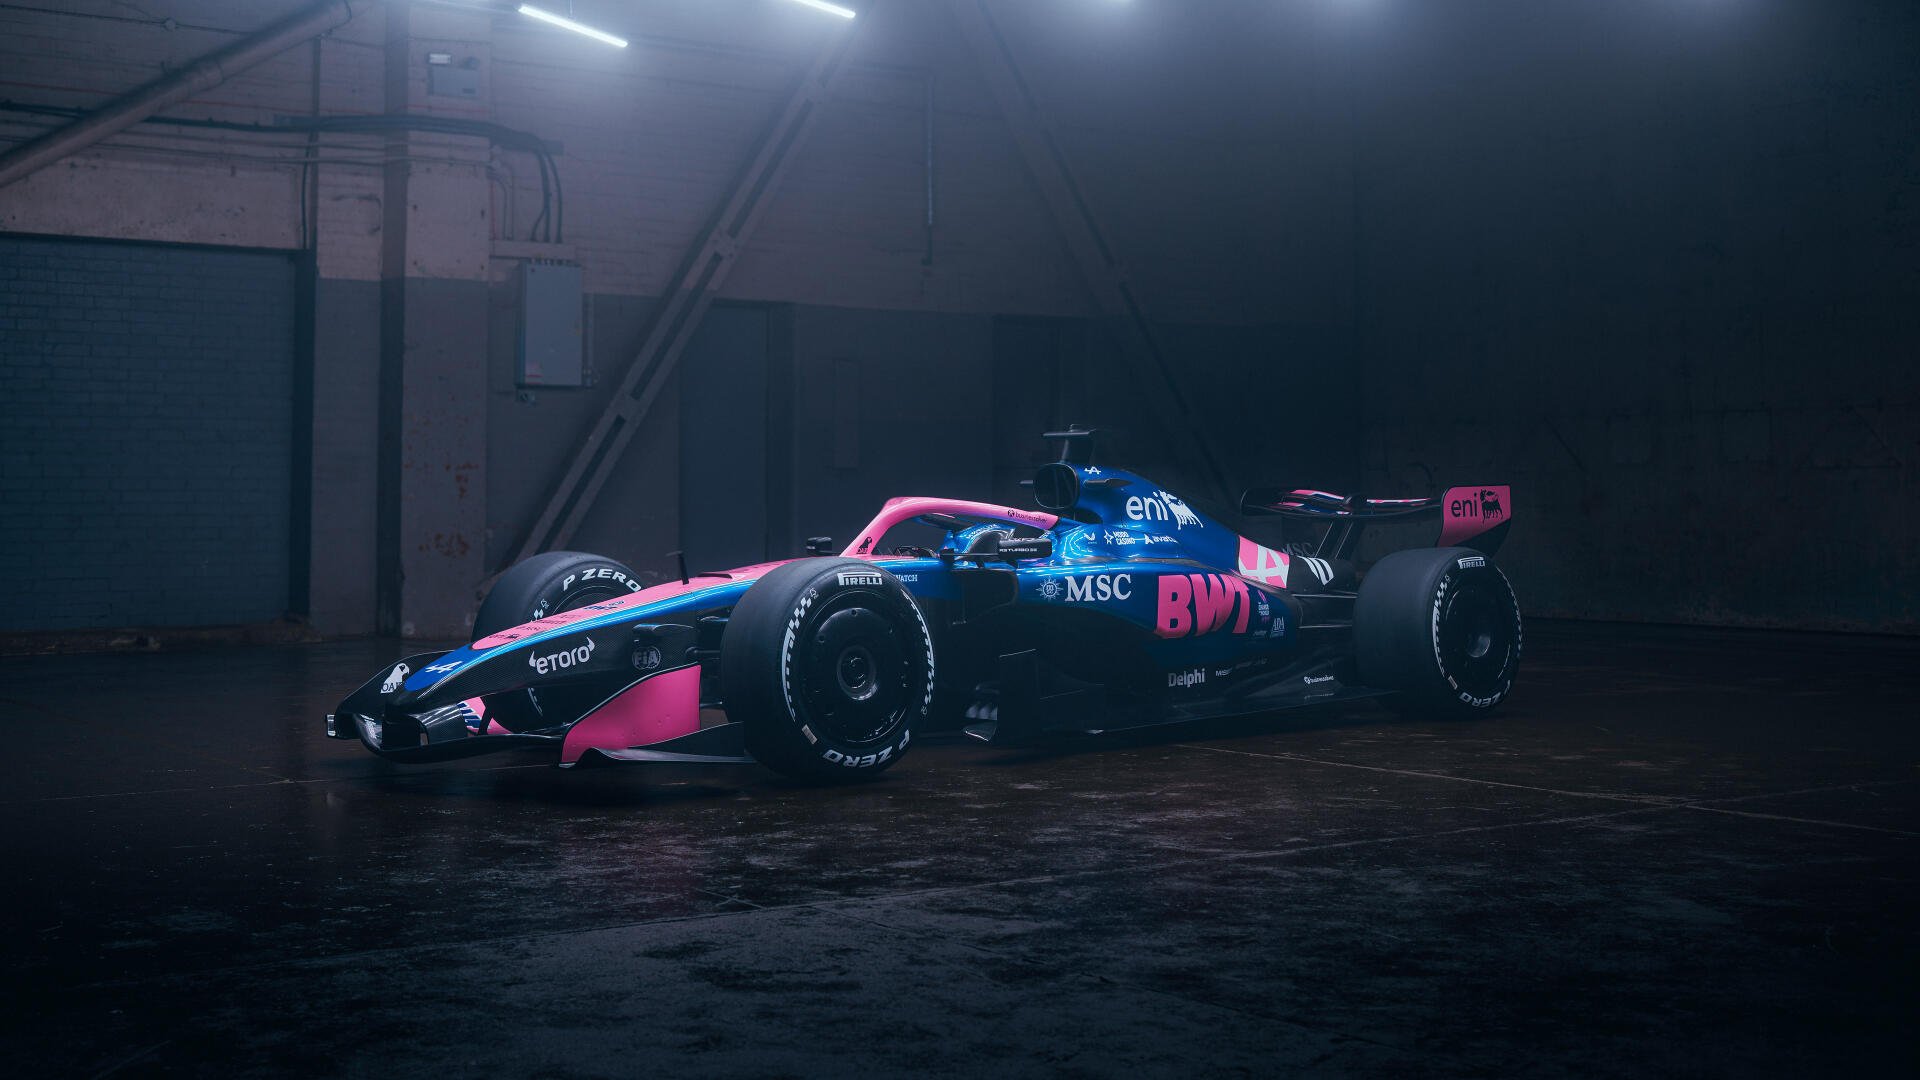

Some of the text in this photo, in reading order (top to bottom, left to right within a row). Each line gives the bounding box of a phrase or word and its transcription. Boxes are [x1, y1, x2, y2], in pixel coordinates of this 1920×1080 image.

[1126, 490, 1168, 521] eni
[1451, 493, 1478, 518] eni
[1458, 556, 1485, 569] PIRELLI
[563, 568, 642, 592] P ZERO
[837, 571, 882, 586] PIRELLI
[1064, 573, 1132, 602] MSC
[1154, 573, 1250, 639] BWT
[633, 650, 659, 665] FIA
[1168, 668, 1206, 688] Delphi
[1459, 692, 1502, 707] ZERO
[822, 729, 910, 768] P ZERO
